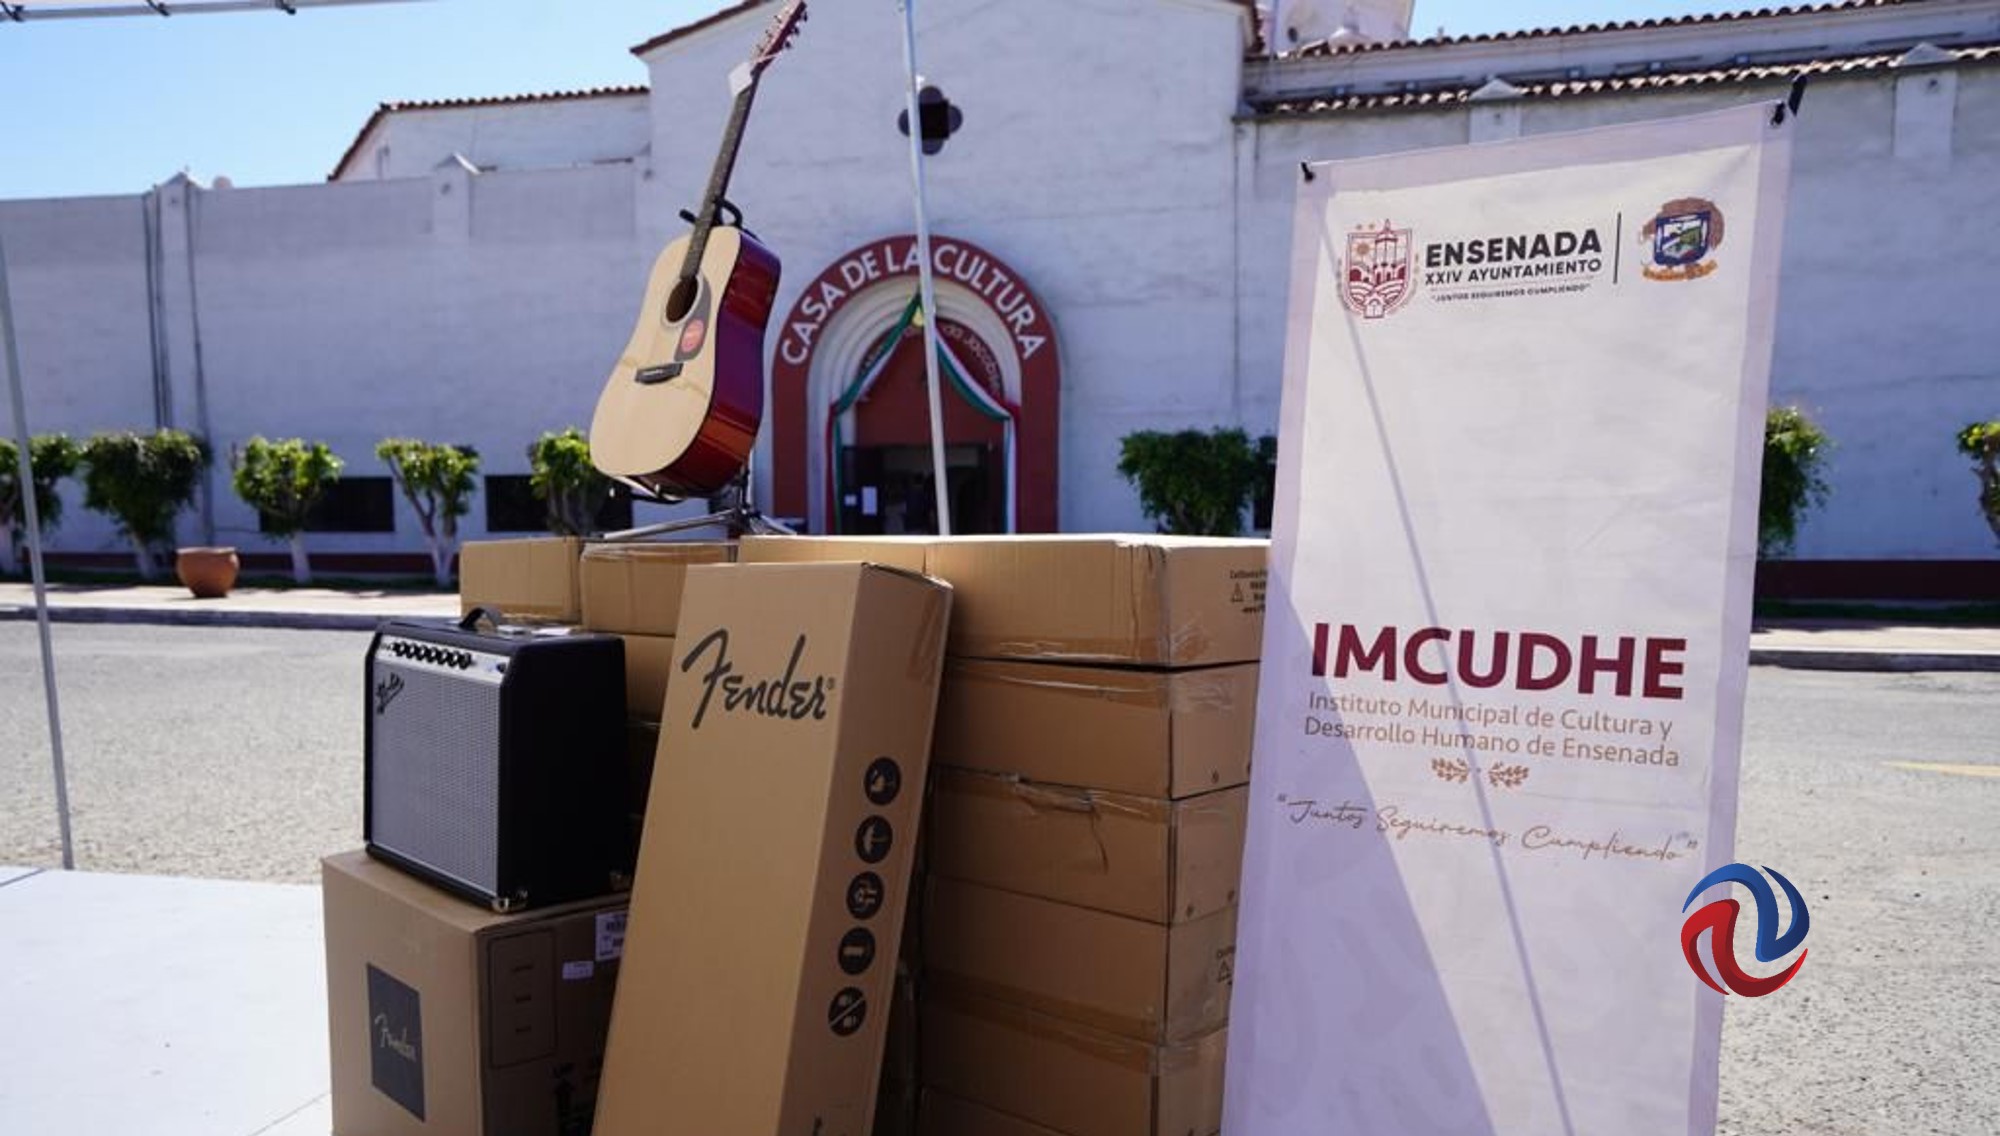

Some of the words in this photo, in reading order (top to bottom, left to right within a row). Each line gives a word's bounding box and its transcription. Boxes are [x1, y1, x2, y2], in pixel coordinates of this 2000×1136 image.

[1425, 228, 1602, 268] ENSENADA
[1425, 271, 1462, 286] XXIV
[1467, 258, 1602, 282] AYUNTAMIENTO
[781, 281, 846, 365] CASA
[840, 250, 881, 290] DE
[885, 242, 921, 273] LA
[933, 243, 1047, 360] CULTURA
[681, 628, 827, 730] Fender
[1312, 622, 1688, 699] IMCUDHE
[1305, 716, 1415, 744] Desarrollo
[1422, 726, 1520, 755] Humano
[1526, 731, 1556, 755] de
[1562, 735, 1680, 768] Ensenada
[1309, 691, 1402, 717] Instituto
[1407, 697, 1519, 730] Municipal
[1526, 707, 1555, 728] de
[1561, 709, 1653, 736] Cultura
[1658, 720, 1673, 741] y
